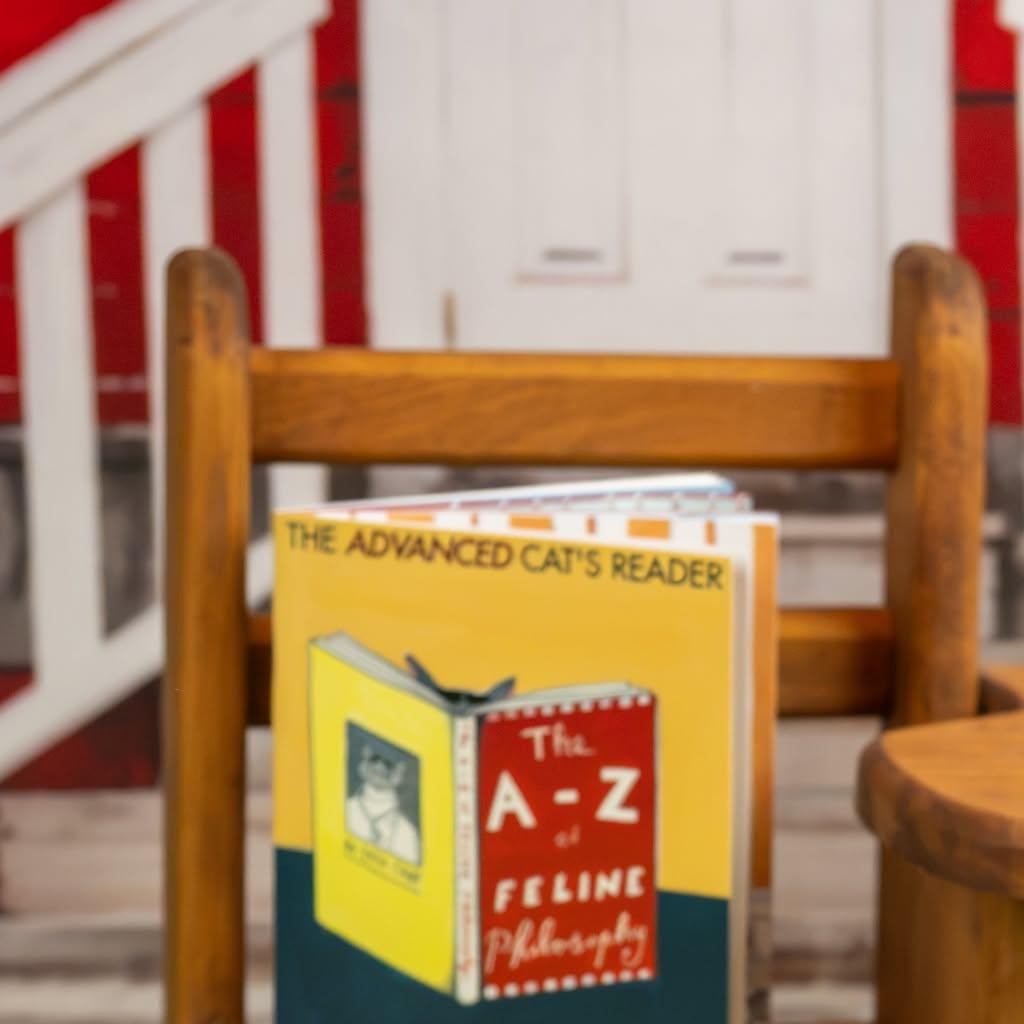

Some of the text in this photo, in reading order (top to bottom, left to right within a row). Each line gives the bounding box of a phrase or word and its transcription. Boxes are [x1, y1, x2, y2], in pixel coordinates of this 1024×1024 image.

[286, 521, 724, 590] THE ADVANCED CAT'S READER
[519, 721, 597, 762] The
[493, 865, 647, 914] FELINE
